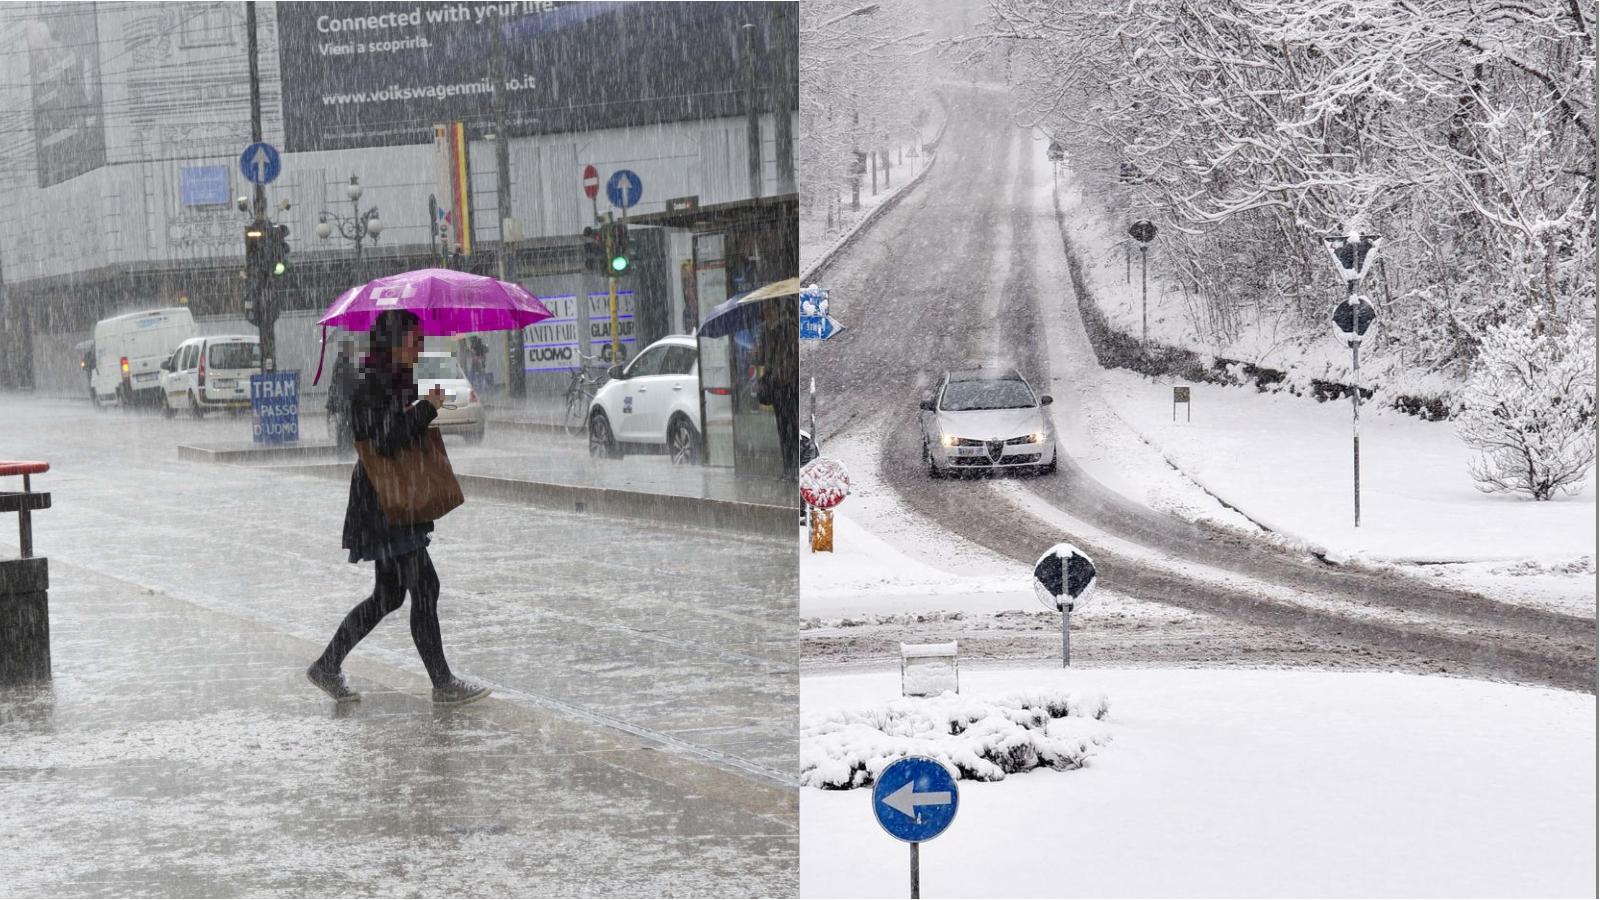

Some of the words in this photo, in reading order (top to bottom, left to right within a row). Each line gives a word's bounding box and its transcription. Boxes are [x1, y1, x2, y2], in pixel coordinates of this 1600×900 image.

[317, 6, 420, 33] Connected
[426, 3, 471, 23] with
[474, 2, 518, 24] your
[319, 41, 355, 56] Vieni
[357, 43, 366, 53] a
[369, 35, 433, 54] scoprirla.
[322, 73, 536, 105] www.volkswagenmilo.it
[591, 321, 634, 338] GLAOUR
[253, 381, 295, 398] TRAM
[261, 404, 297, 417] PASSO
